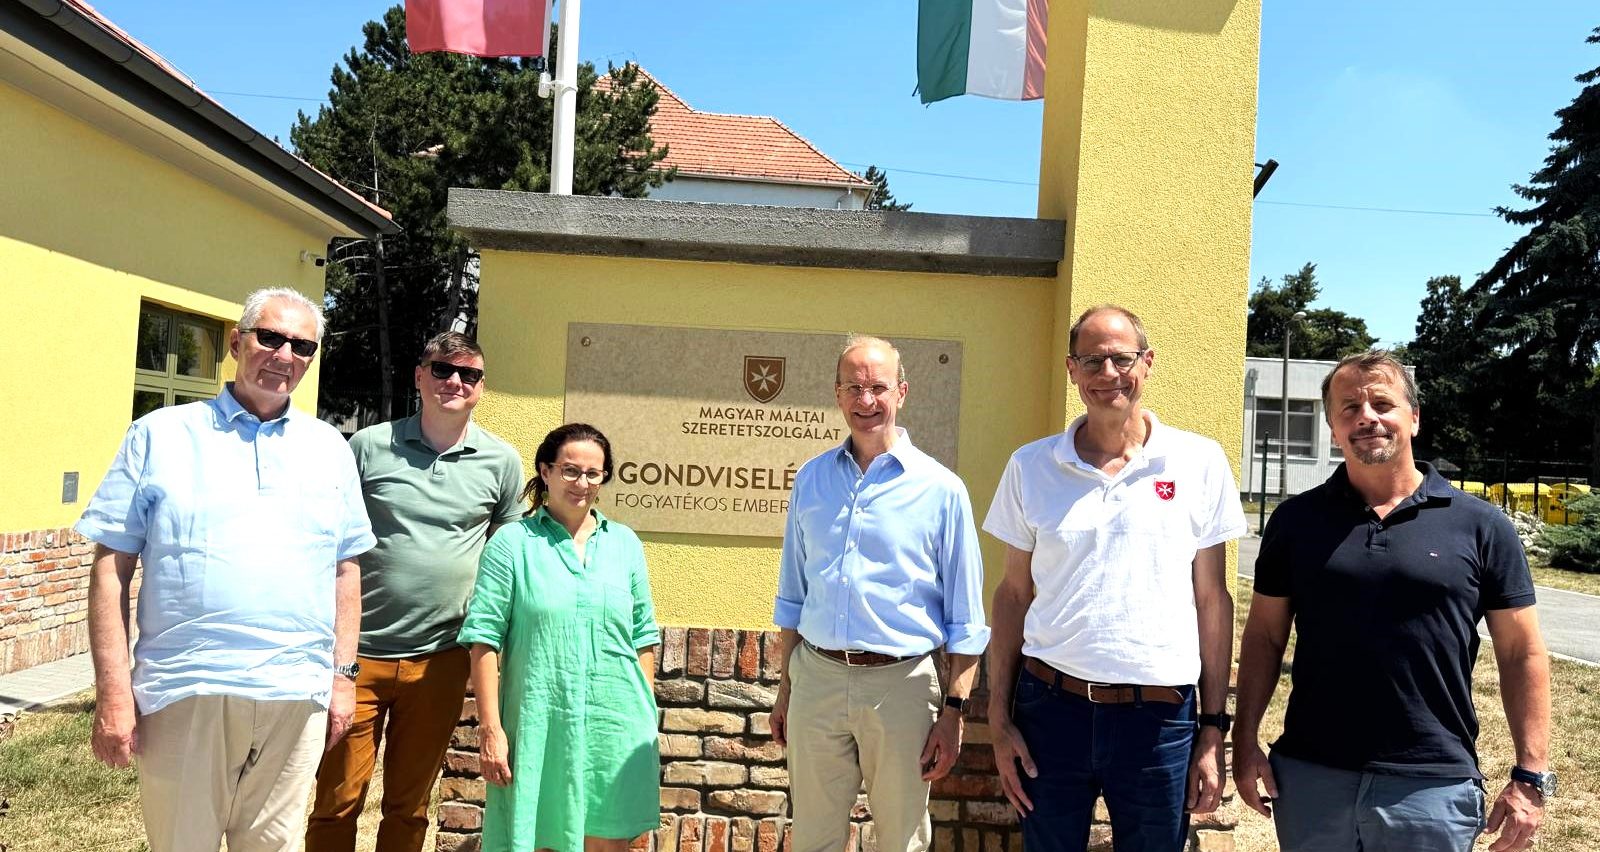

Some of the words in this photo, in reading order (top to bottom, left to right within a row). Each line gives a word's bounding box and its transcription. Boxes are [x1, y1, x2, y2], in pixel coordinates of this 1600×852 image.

[699, 406, 765, 421] MAGYAR
[769, 407, 825, 424] MÁLTAI
[681, 421, 841, 440] SZERETETSZOLGÁLAT
[615, 492, 728, 512] FOGYATÉKOS
